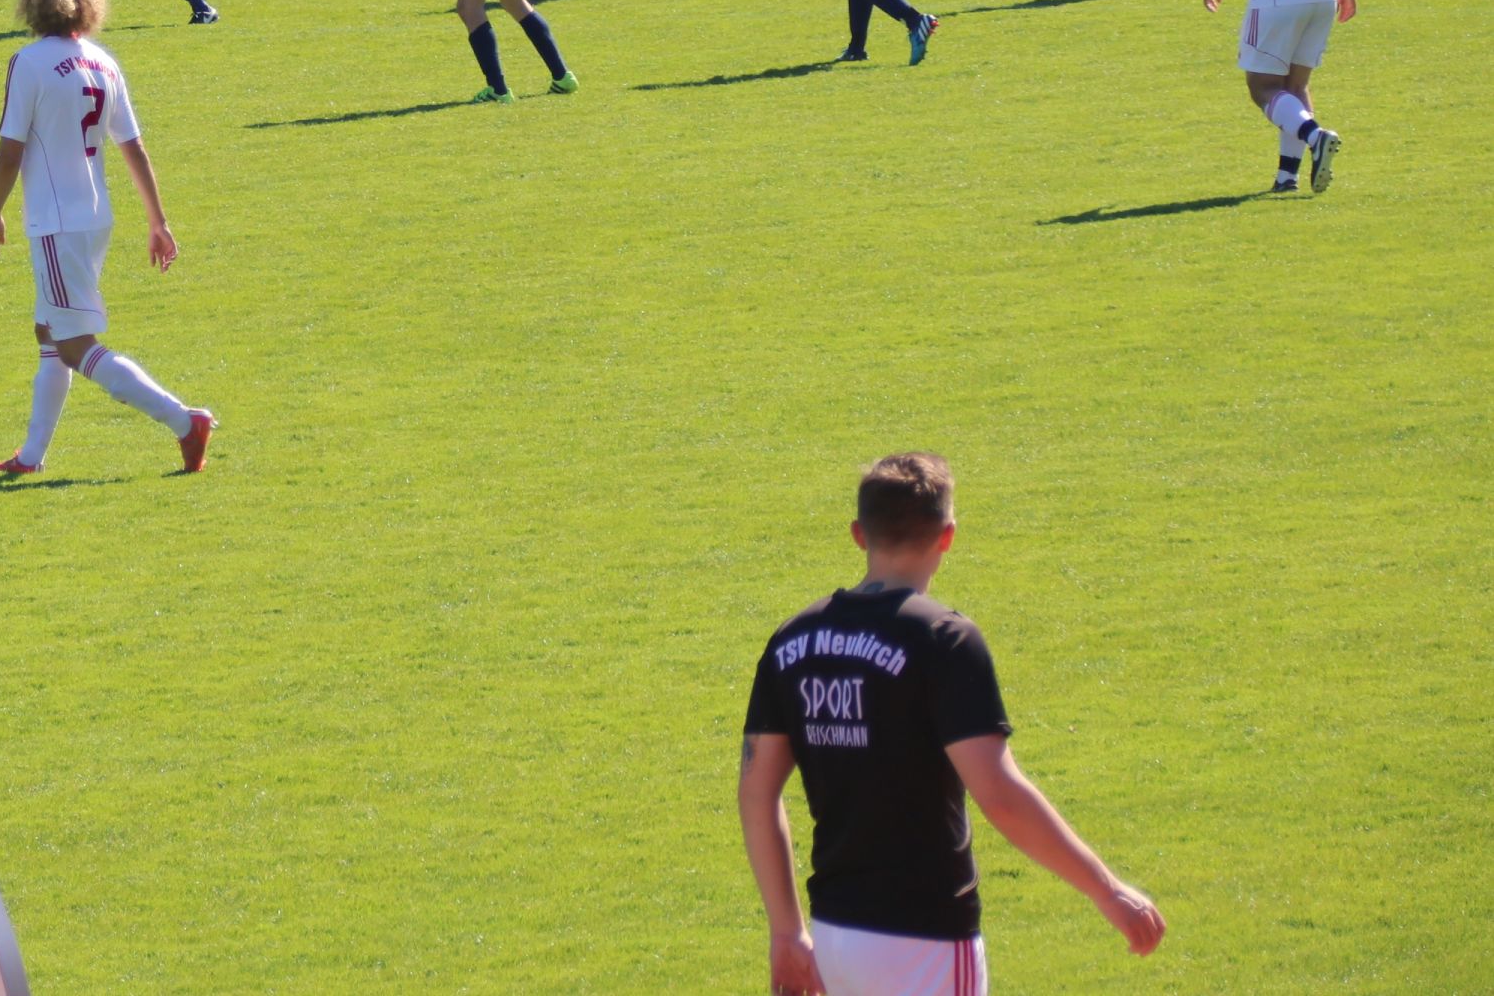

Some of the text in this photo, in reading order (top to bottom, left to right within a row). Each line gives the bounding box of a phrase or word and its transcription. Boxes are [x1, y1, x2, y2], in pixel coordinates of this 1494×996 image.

[54, 57, 76, 78] TSV
[81, 86, 105, 157] 2
[775, 629, 907, 676] TSV Neukirch
[800, 677, 864, 720] SPORT
[805, 724, 868, 748] REISCHMANN
